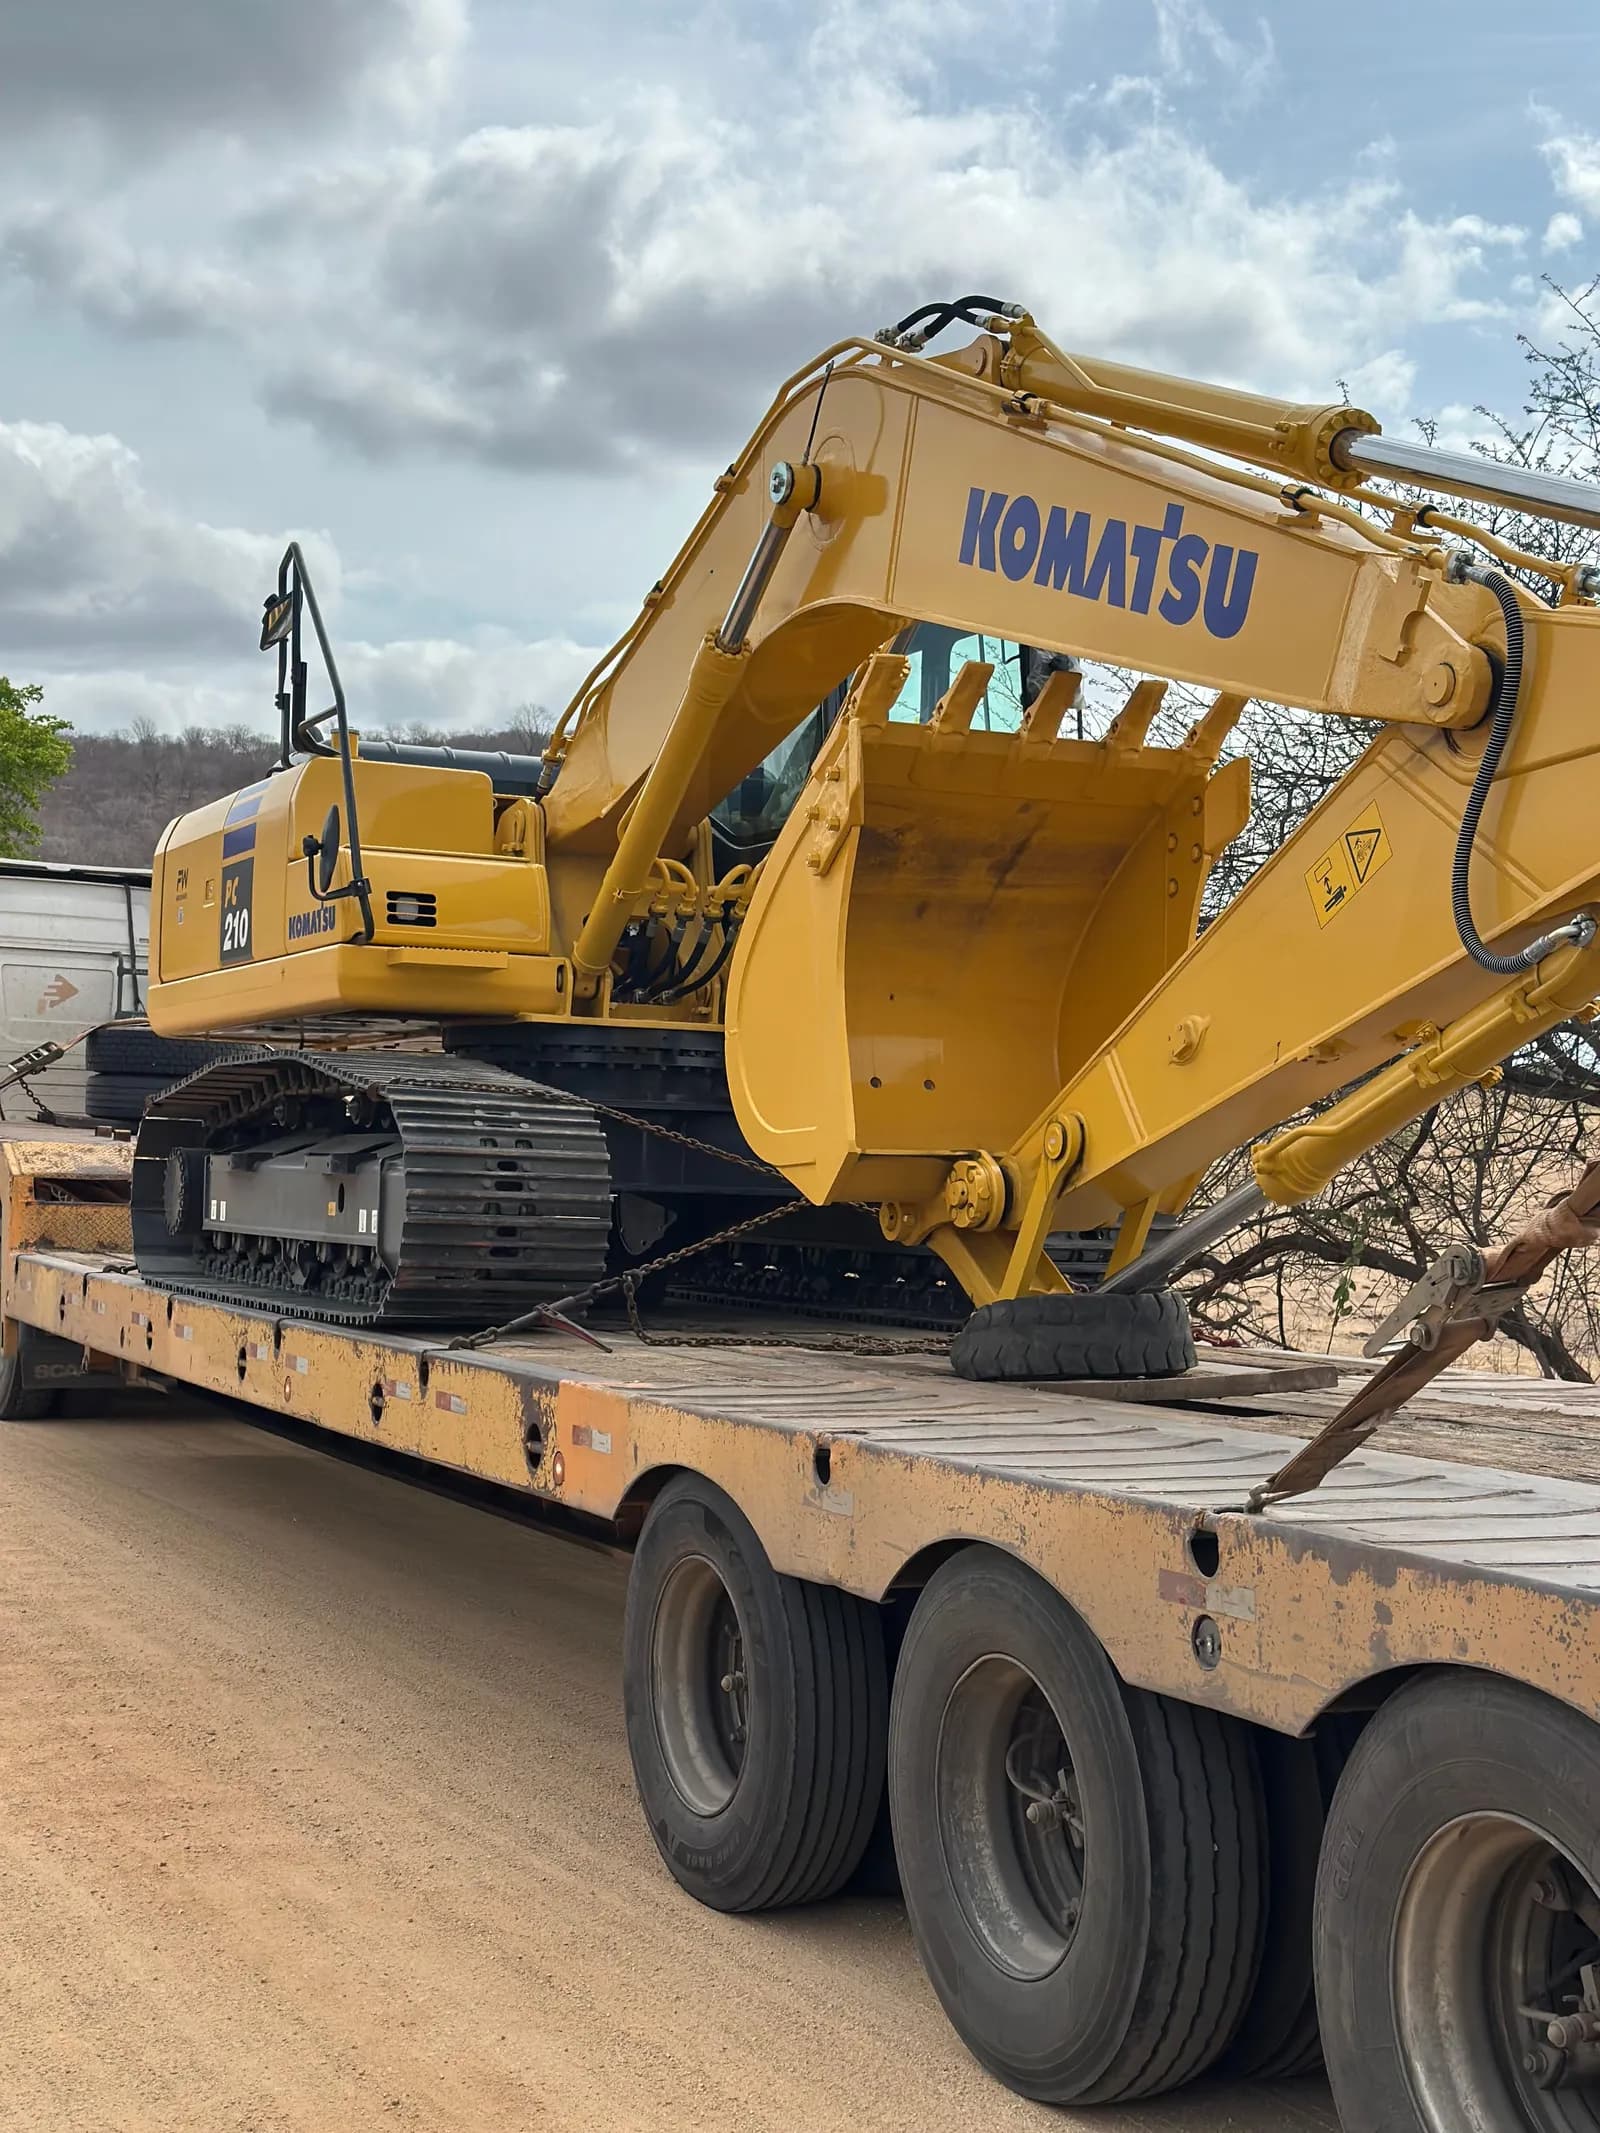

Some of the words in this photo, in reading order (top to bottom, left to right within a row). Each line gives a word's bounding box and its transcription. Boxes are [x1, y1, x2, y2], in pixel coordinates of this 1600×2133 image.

[958, 487, 1259, 639] KOMATSU
[224, 876, 239, 908] PC
[223, 908, 249, 952] 210
[288, 900, 336, 941] KOMATSU
